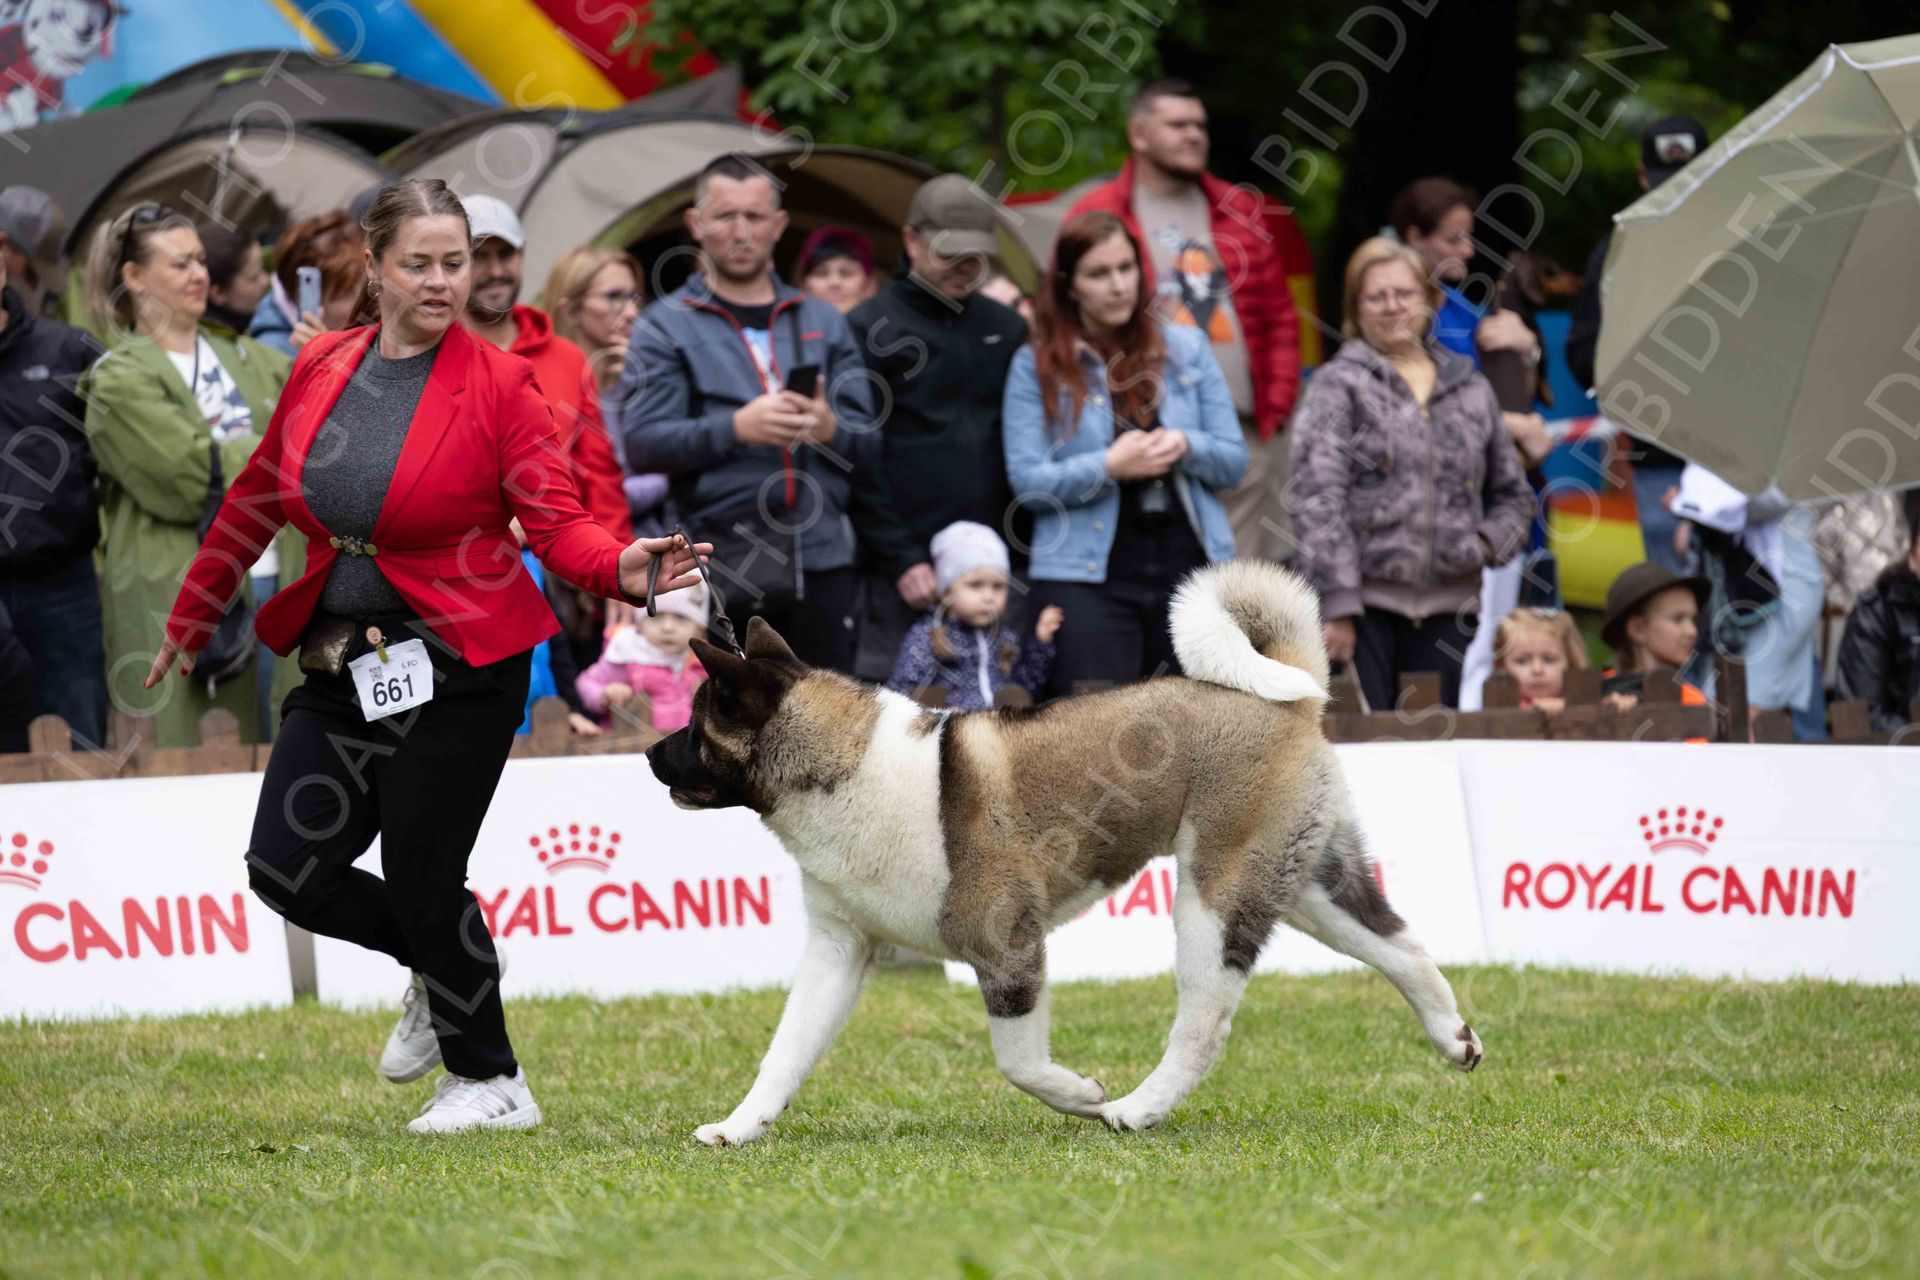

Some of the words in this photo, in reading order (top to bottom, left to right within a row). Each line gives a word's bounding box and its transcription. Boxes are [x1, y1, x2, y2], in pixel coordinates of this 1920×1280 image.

[373, 673, 414, 707] 661
[472, 885, 573, 938] YAL
[588, 876, 770, 932] CANIN
[1502, 862, 1665, 912] ROYAL
[1681, 865, 1856, 918] CANIN
[14, 892, 249, 963] CANIN
